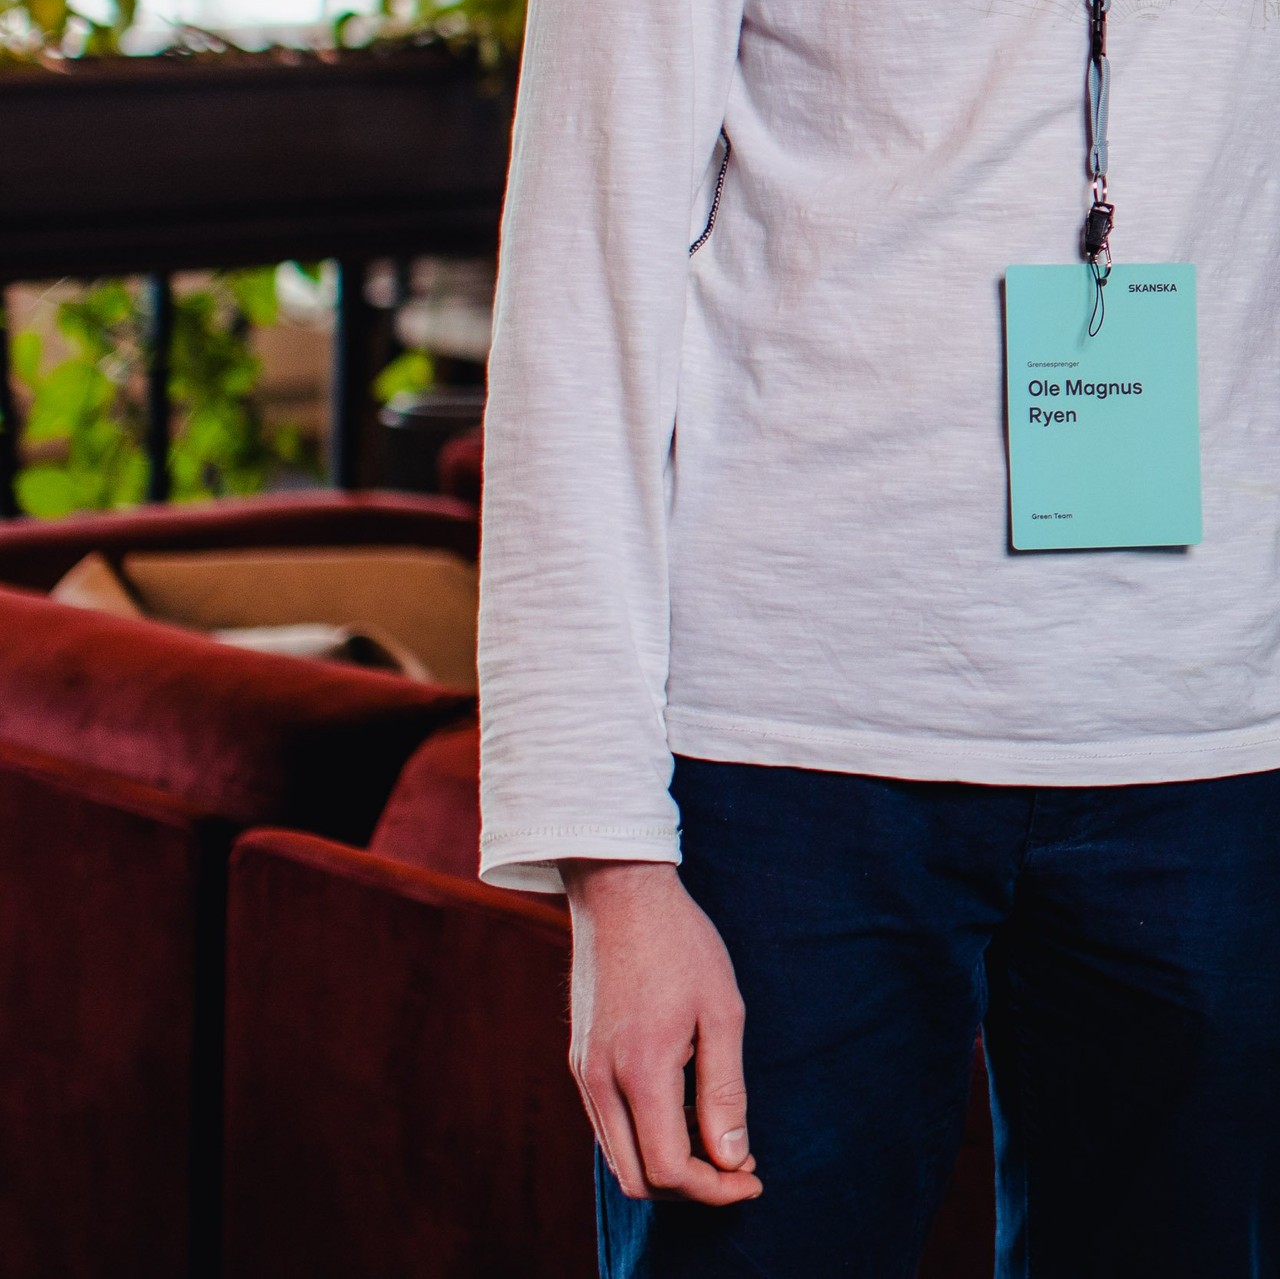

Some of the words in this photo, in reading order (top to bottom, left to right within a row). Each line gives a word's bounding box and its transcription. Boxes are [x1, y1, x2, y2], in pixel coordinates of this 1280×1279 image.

[1128, 283, 1178, 293] SKANSKA
[1026, 360, 1080, 369] Grensesprenger
[1028, 379, 1061, 397] Ole
[1065, 379, 1143, 400] Magnus
[1029, 406, 1077, 428] Ryen
[1053, 512, 1073, 520] Team
